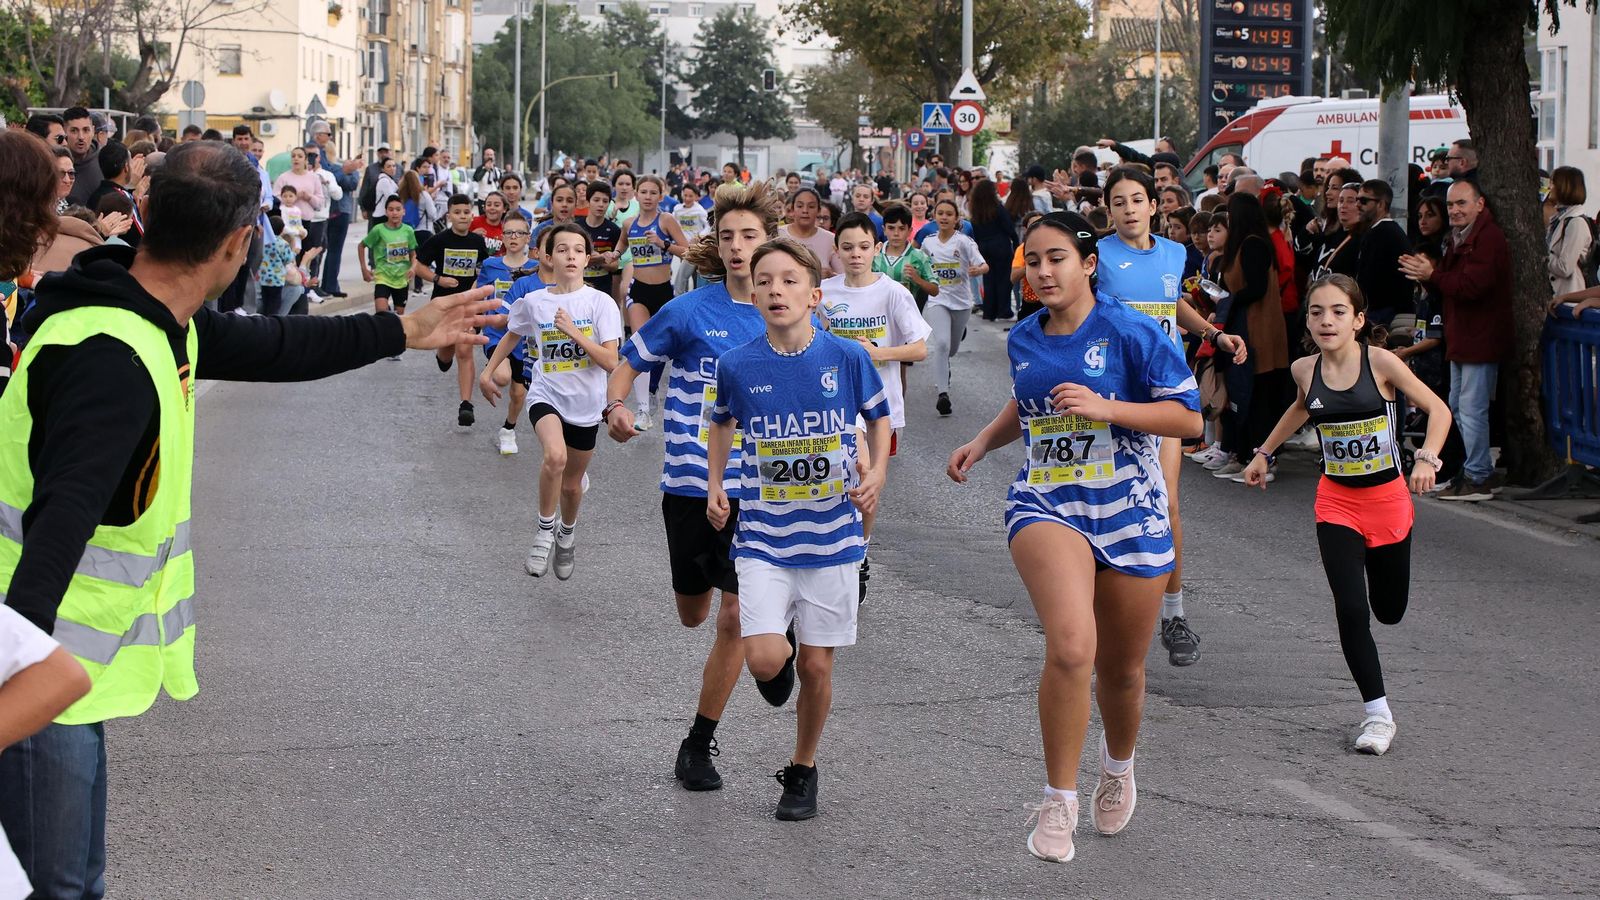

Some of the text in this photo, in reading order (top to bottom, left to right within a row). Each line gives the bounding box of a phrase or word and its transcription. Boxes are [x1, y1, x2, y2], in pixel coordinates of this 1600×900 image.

[1253, 3, 1292, 17] 1.459
[1240, 28, 1249, 40] 5
[1252, 30, 1292, 44] 1.499
[1252, 57, 1291, 72] 1.549
[959, 113, 976, 124] 30
[1316, 112, 1379, 125] AMBULAN
[1360, 148, 1378, 166] Cr
[631, 245, 655, 256] 204
[450, 258, 473, 268] 752
[828, 315, 887, 328] AMPEONATO
[706, 329, 728, 338] vive
[546, 342, 587, 360] 766
[749, 384, 772, 394] vive
[750, 408, 845, 438] CHAPIN
[1032, 417, 1051, 428] CARRERA
[1051, 416, 1074, 425] INFANTIL
[1041, 422, 1092, 434] BOMBEROS DE JEREZ
[760, 436, 836, 448] CARRERA INFANTIL BENEFICA
[1332, 436, 1380, 460] 604
[772, 447, 802, 456] BOMBEROS
[812, 444, 828, 454] JEREZ
[1040, 435, 1096, 463] 787
[772, 457, 830, 482] 209
